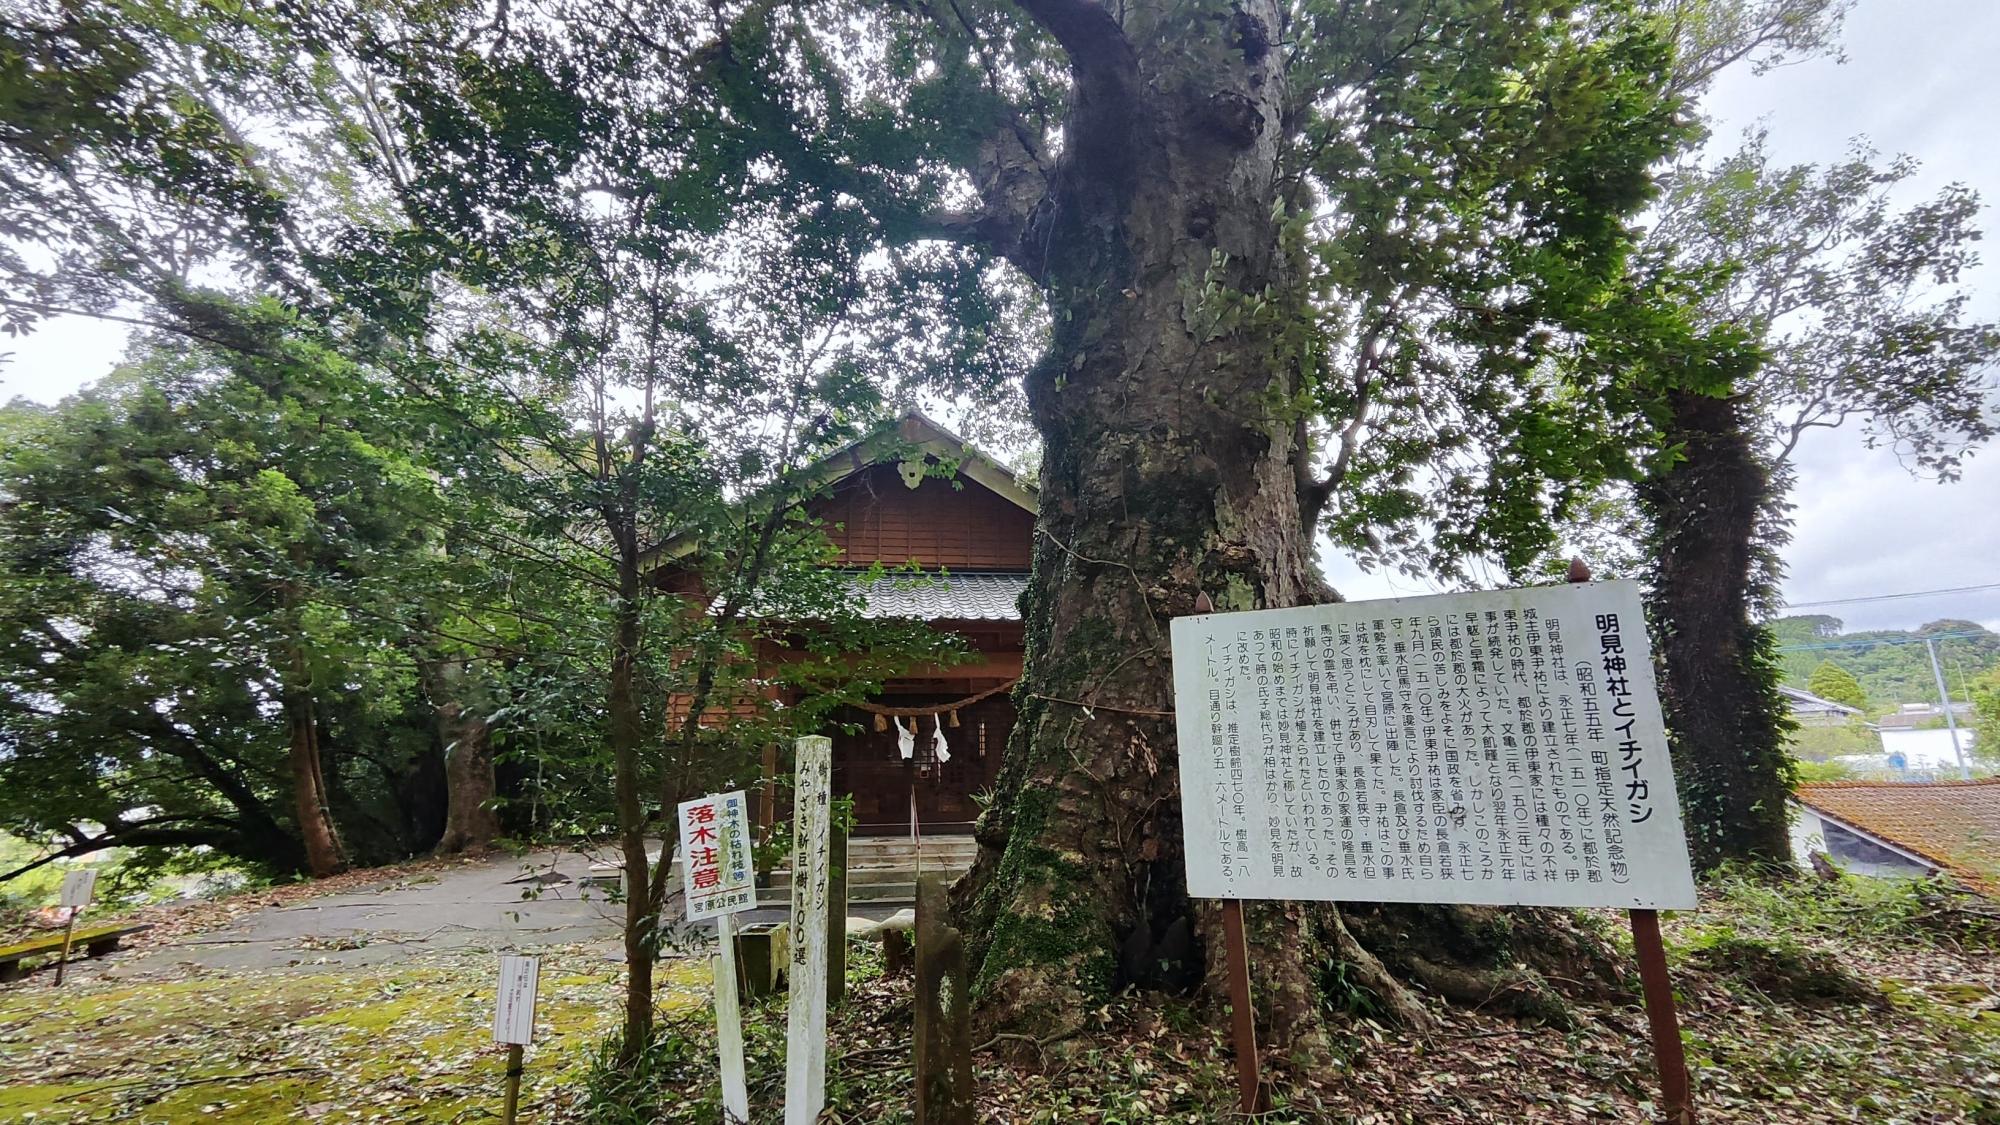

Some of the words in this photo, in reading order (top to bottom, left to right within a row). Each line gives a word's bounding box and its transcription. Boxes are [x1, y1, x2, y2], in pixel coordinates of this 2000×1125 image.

[1235, 630, 1252, 681] に改めた。
[1593, 612, 1653, 824] 明見神社とイチイガシ
[687, 804, 720, 890] 落木注意
[693, 893, 749, 914] 宮原公民館
